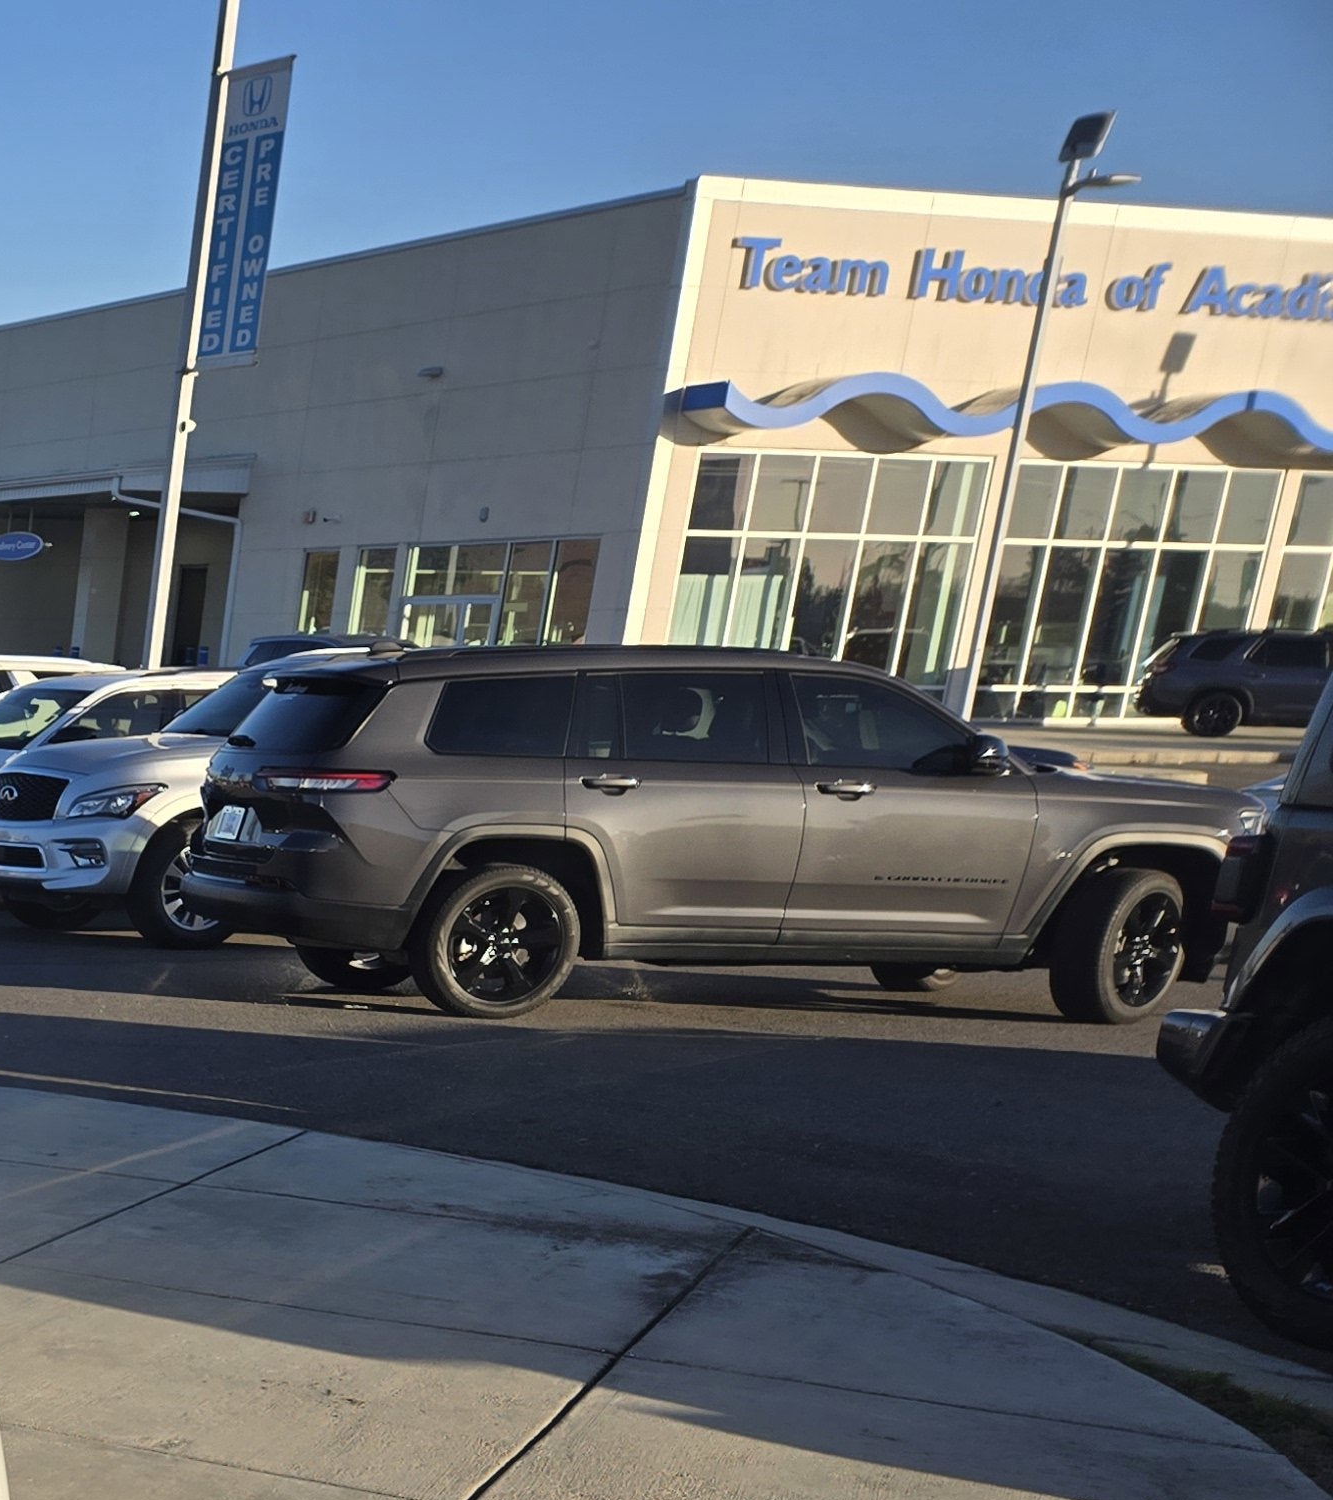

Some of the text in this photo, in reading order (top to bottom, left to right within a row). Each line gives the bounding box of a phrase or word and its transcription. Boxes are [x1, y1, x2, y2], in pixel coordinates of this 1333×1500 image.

[228, 117, 279, 138] HONDA
[201, 145, 244, 352] CERTIFIED
[235, 138, 275, 347] PRE OWNED
[732, 236, 890, 297] Team
[1105, 262, 1173, 311] of
